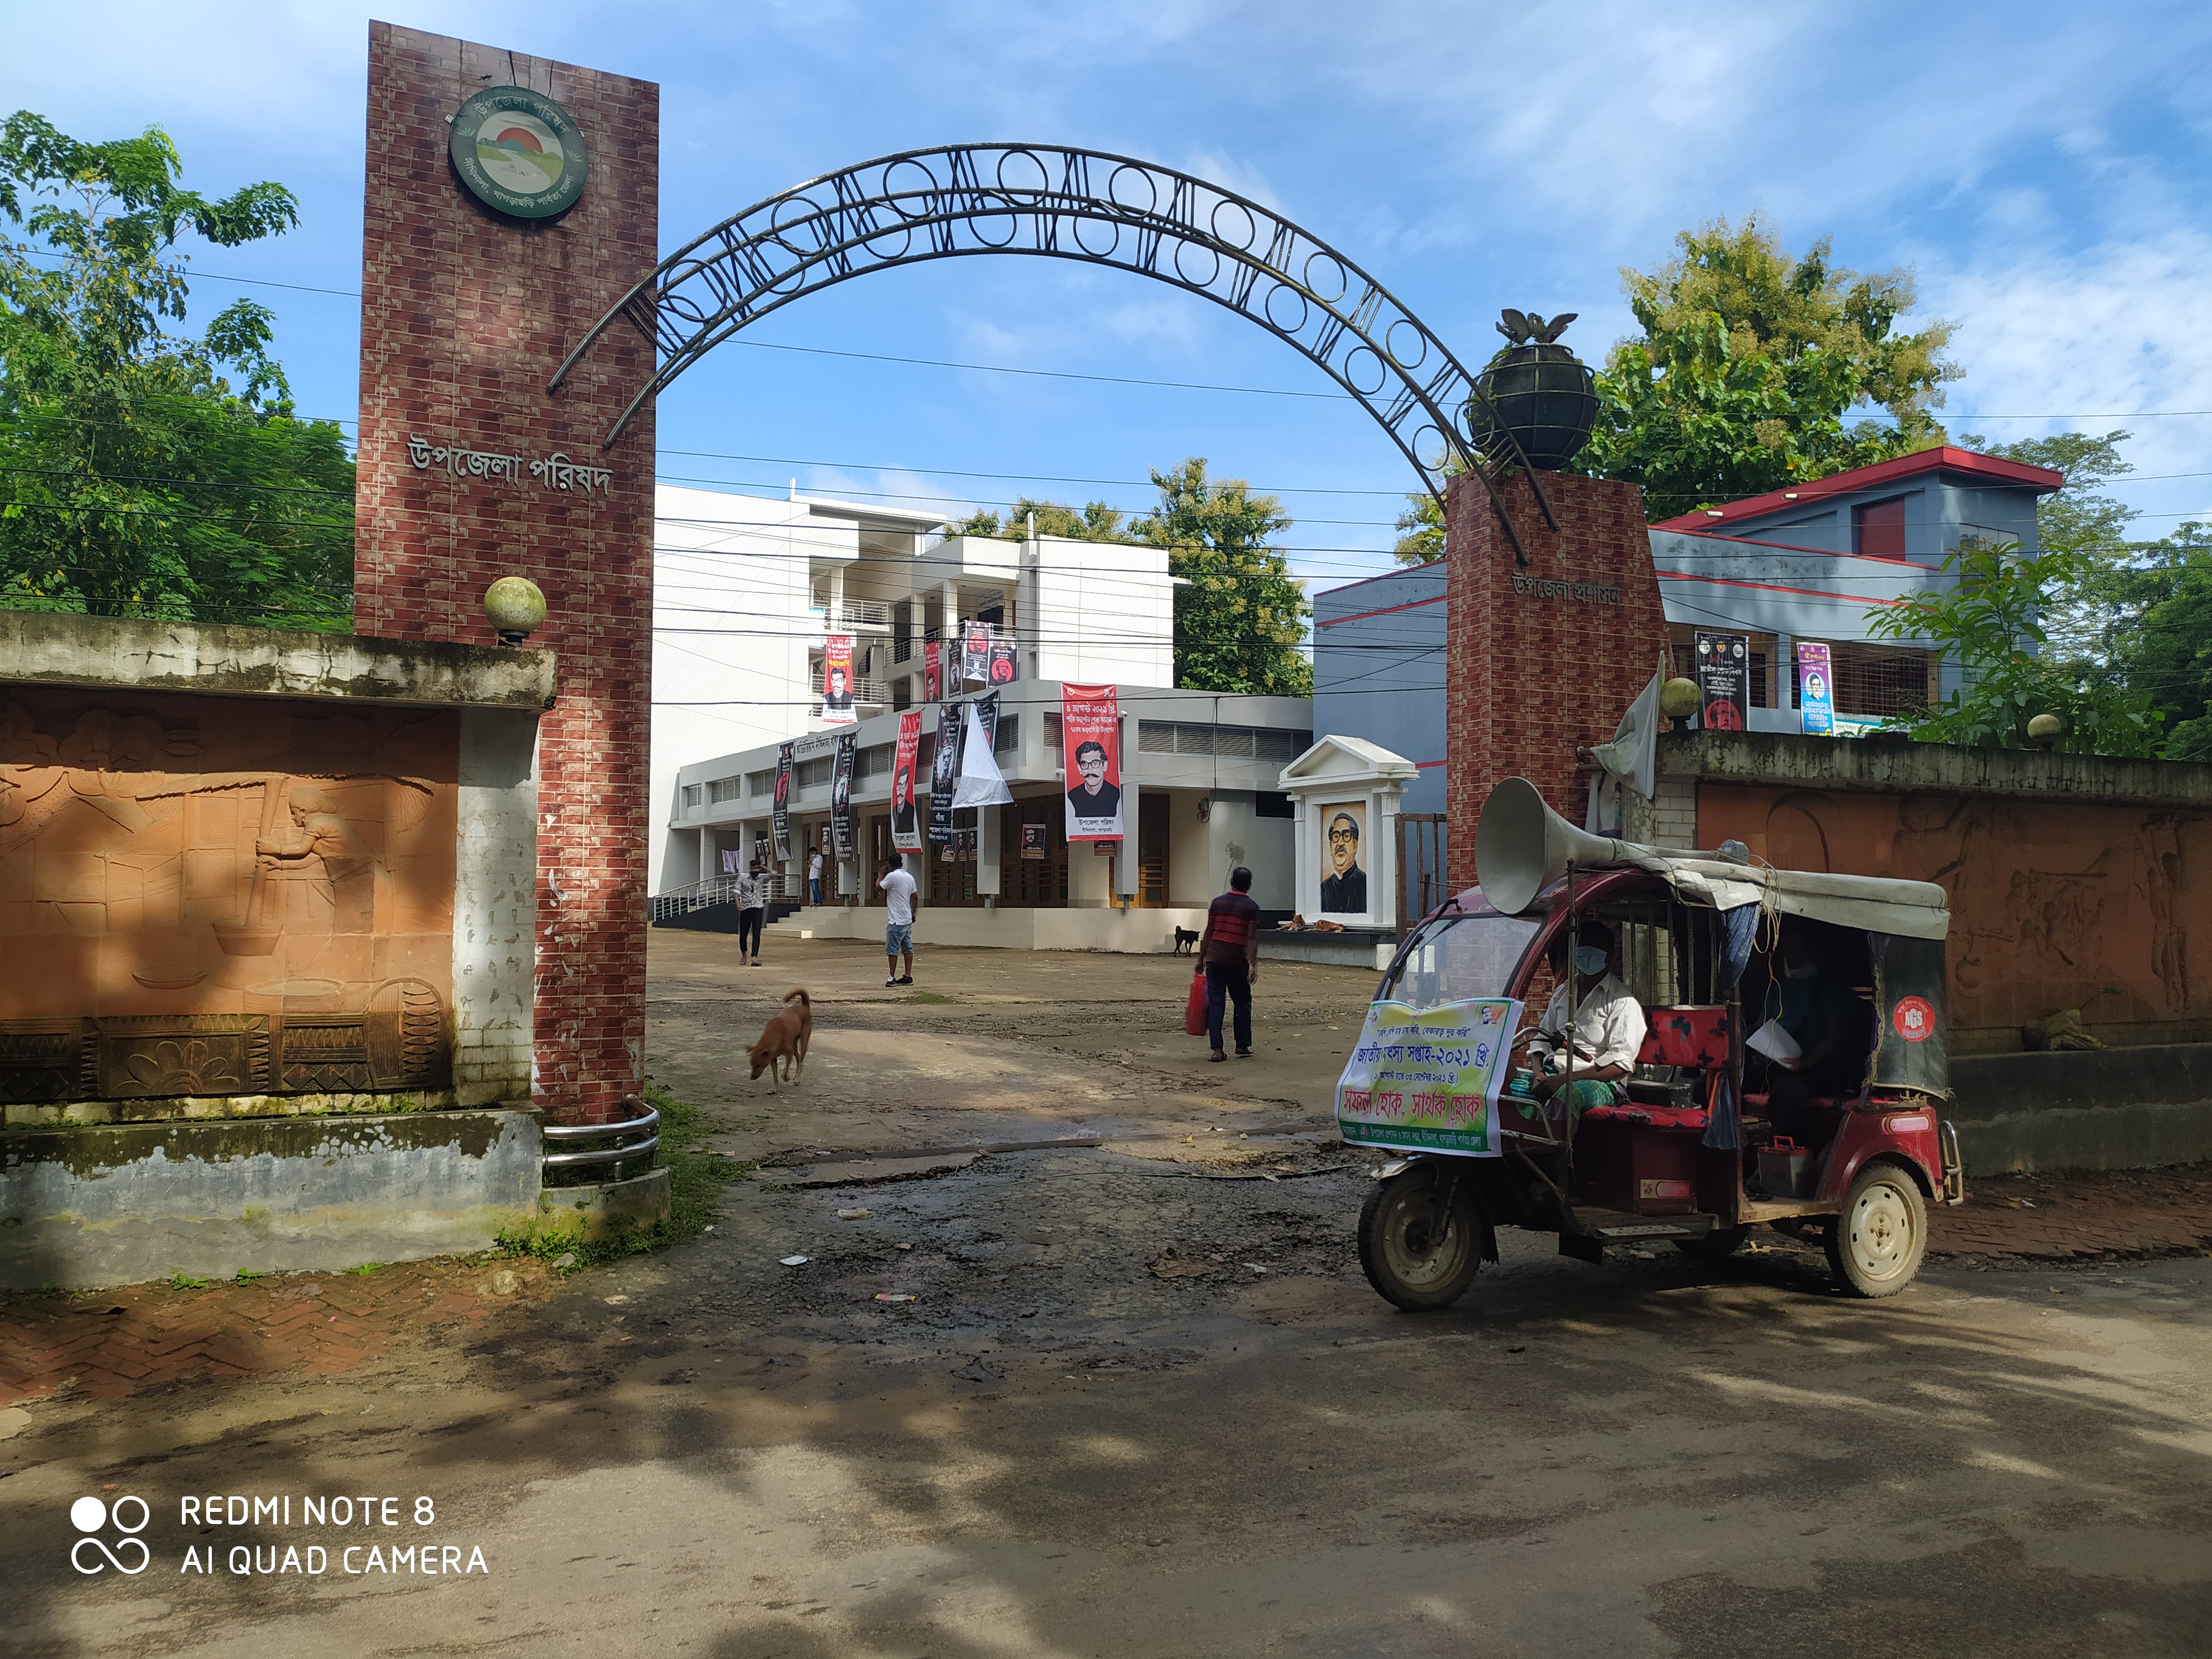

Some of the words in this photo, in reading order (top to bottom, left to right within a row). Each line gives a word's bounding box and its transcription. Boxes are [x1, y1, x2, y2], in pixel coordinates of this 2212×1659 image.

[473, 96, 528, 115] উপজেলা
[533, 102, 570, 133] পরিষদ
[494, 189, 535, 208] খাগড়াছড়ি
[536, 190, 562, 206] পার্বত্য
[560, 174, 574, 194] জেলা
[407, 432, 524, 486] উপজেলা
[529, 452, 614, 496] পরিষদ
[1512, 568, 1571, 602] উপজেলা
[1574, 582, 1621, 607] প্রশাসন
[1072, 702, 1091, 713] আগস্ট
[1092, 705, 1107, 713] ২০২১
[1358, 1041, 1382, 1064] জাতীয়
[1344, 1089, 1372, 1114] সফল
[1375, 1090, 1405, 1121] হোক,
[1412, 1087, 1446, 1120] সার্থক
[1450, 1093, 1481, 1124] হোক
